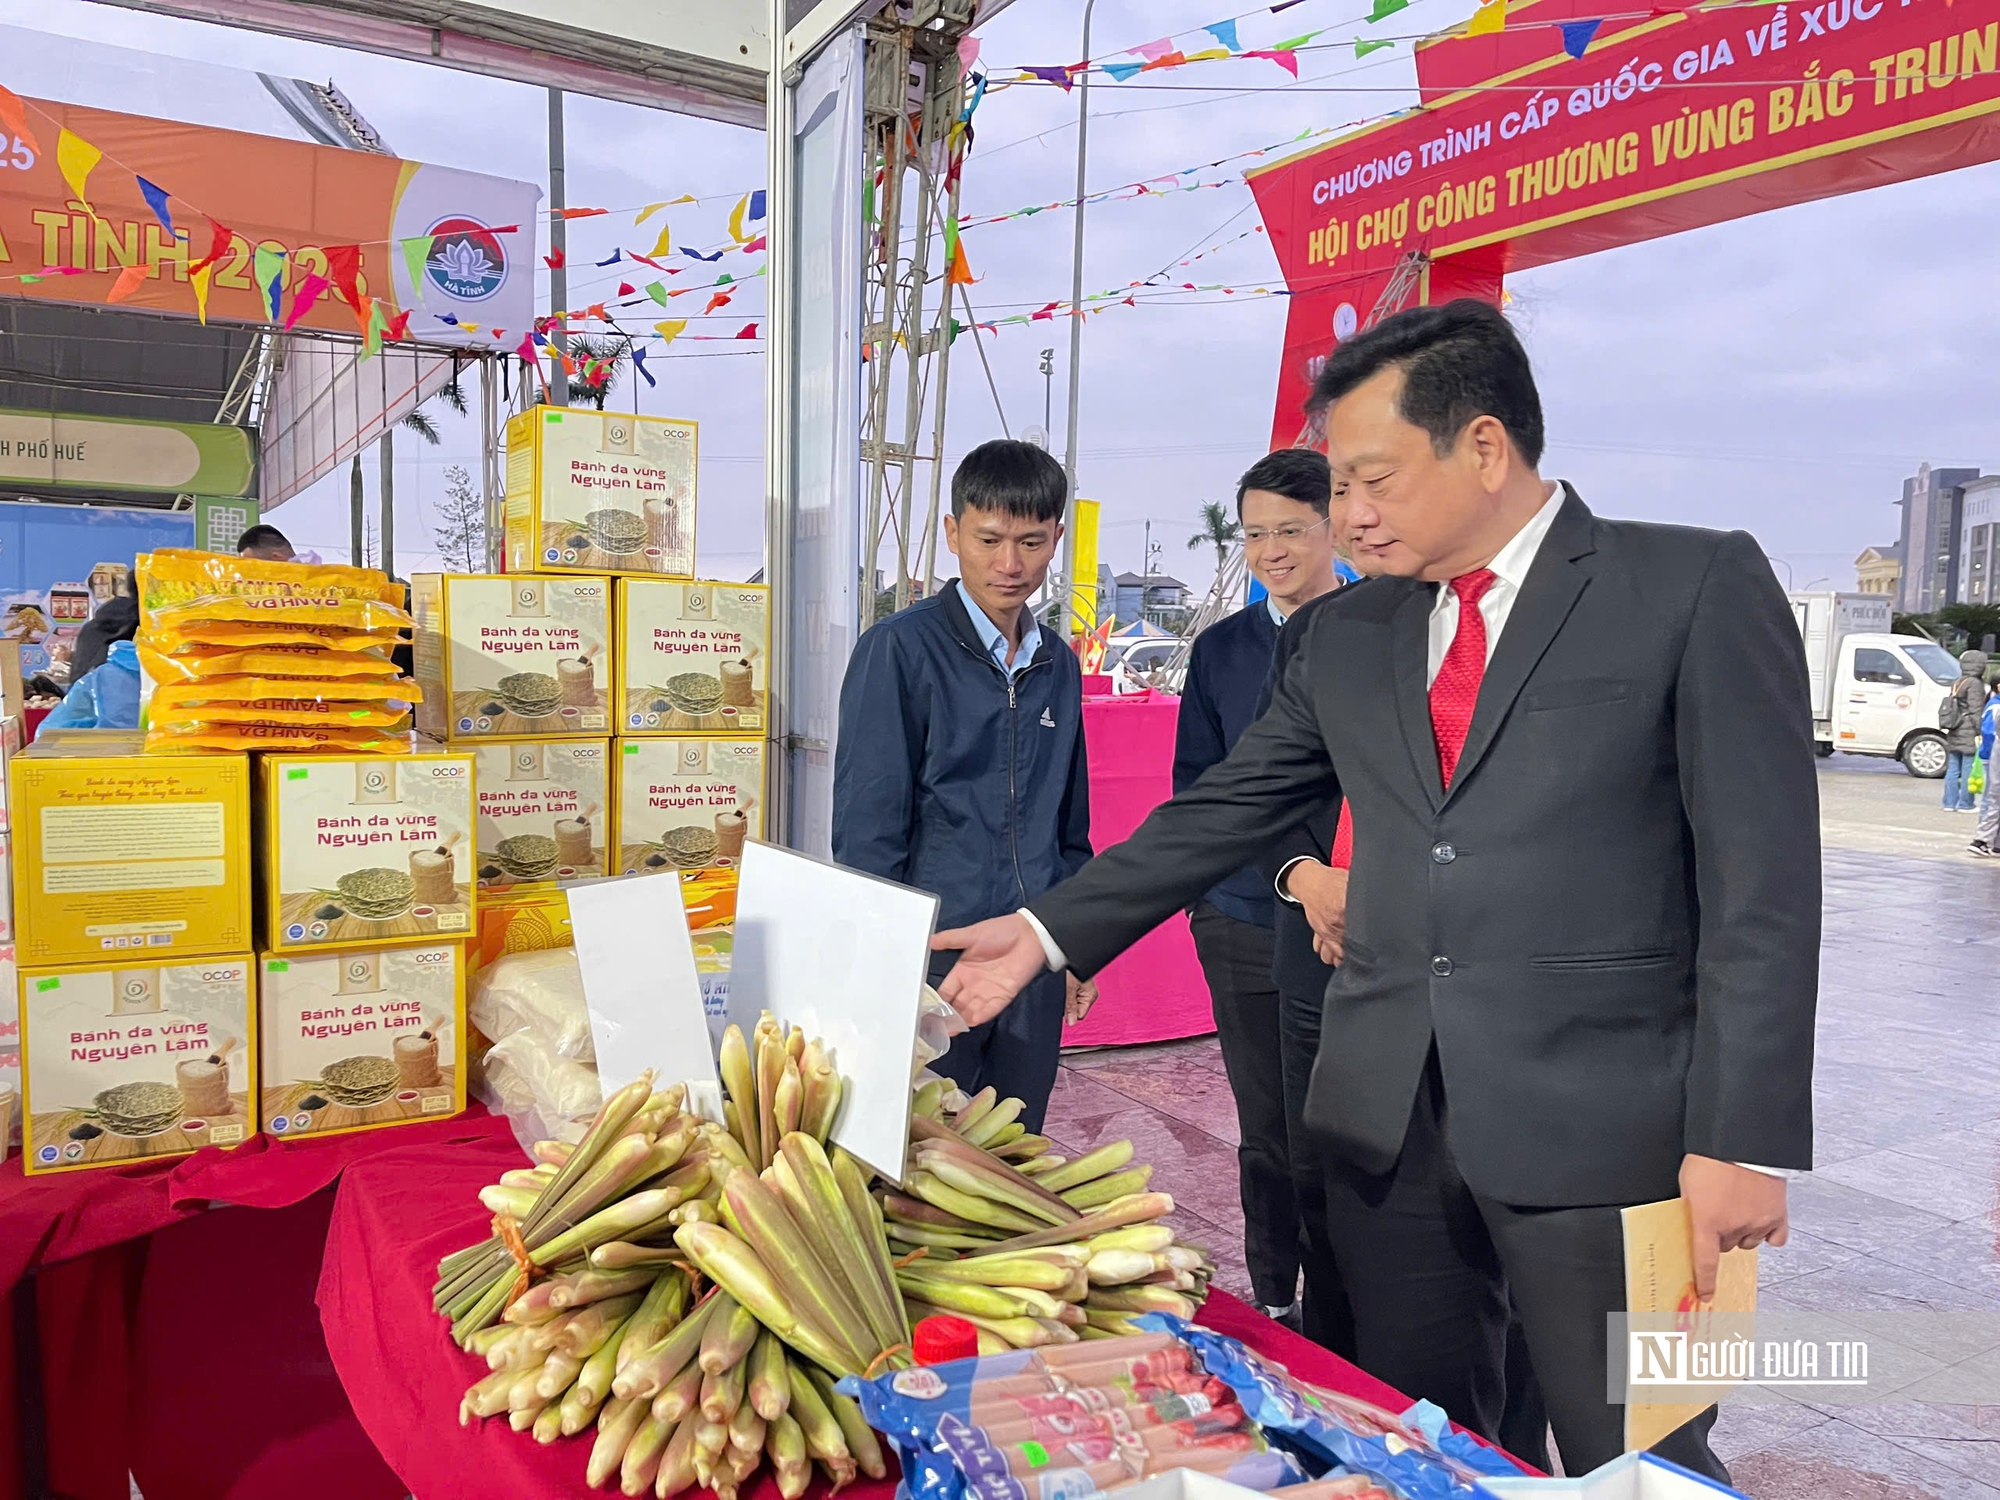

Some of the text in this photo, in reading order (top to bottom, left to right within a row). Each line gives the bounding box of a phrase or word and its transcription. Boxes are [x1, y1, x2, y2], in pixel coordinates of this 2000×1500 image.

[1313, 150, 1412, 204] CHƯƠNG
[1419, 120, 1492, 168] TRÌNH
[1500, 90, 1559, 139] CẤP
[1568, 56, 1663, 116] QUỐC
[1673, 39, 1735, 81] GIA
[1746, 5, 1788, 58] VỀ
[1308, 217, 1349, 267] HỘI
[1357, 198, 1410, 248] CHỢ
[1417, 175, 1496, 233] CÔNG
[1506, 131, 1639, 207] THƯƠNG
[1651, 98, 1755, 166] VÙNG
[1768, 60, 1854, 134] BẮC
[444, 280, 458, 293] HÀ
[663, 428, 690, 439] OCOP
[17, 436, 48, 458] PHỐ
[54, 441, 87, 461] HUẾ
[574, 587, 601, 597] OCOP
[738, 594, 763, 603] OCOP
[573, 749, 600, 758] OCOP
[733, 746, 758, 755] OCOP
[432, 767, 465, 777] OCOP
[317, 816, 361, 828] Bánh
[317, 829, 437, 847] Nguyên Lâm
[416, 952, 449, 963] OCOP
[202, 969, 241, 981] OCOP
[301, 1007, 345, 1021] Bánh
[301, 1015, 421, 1038] Nguyên Lâm
[70, 1029, 120, 1043] Bánh
[71, 1038, 208, 1062] Nguyên Lâm
